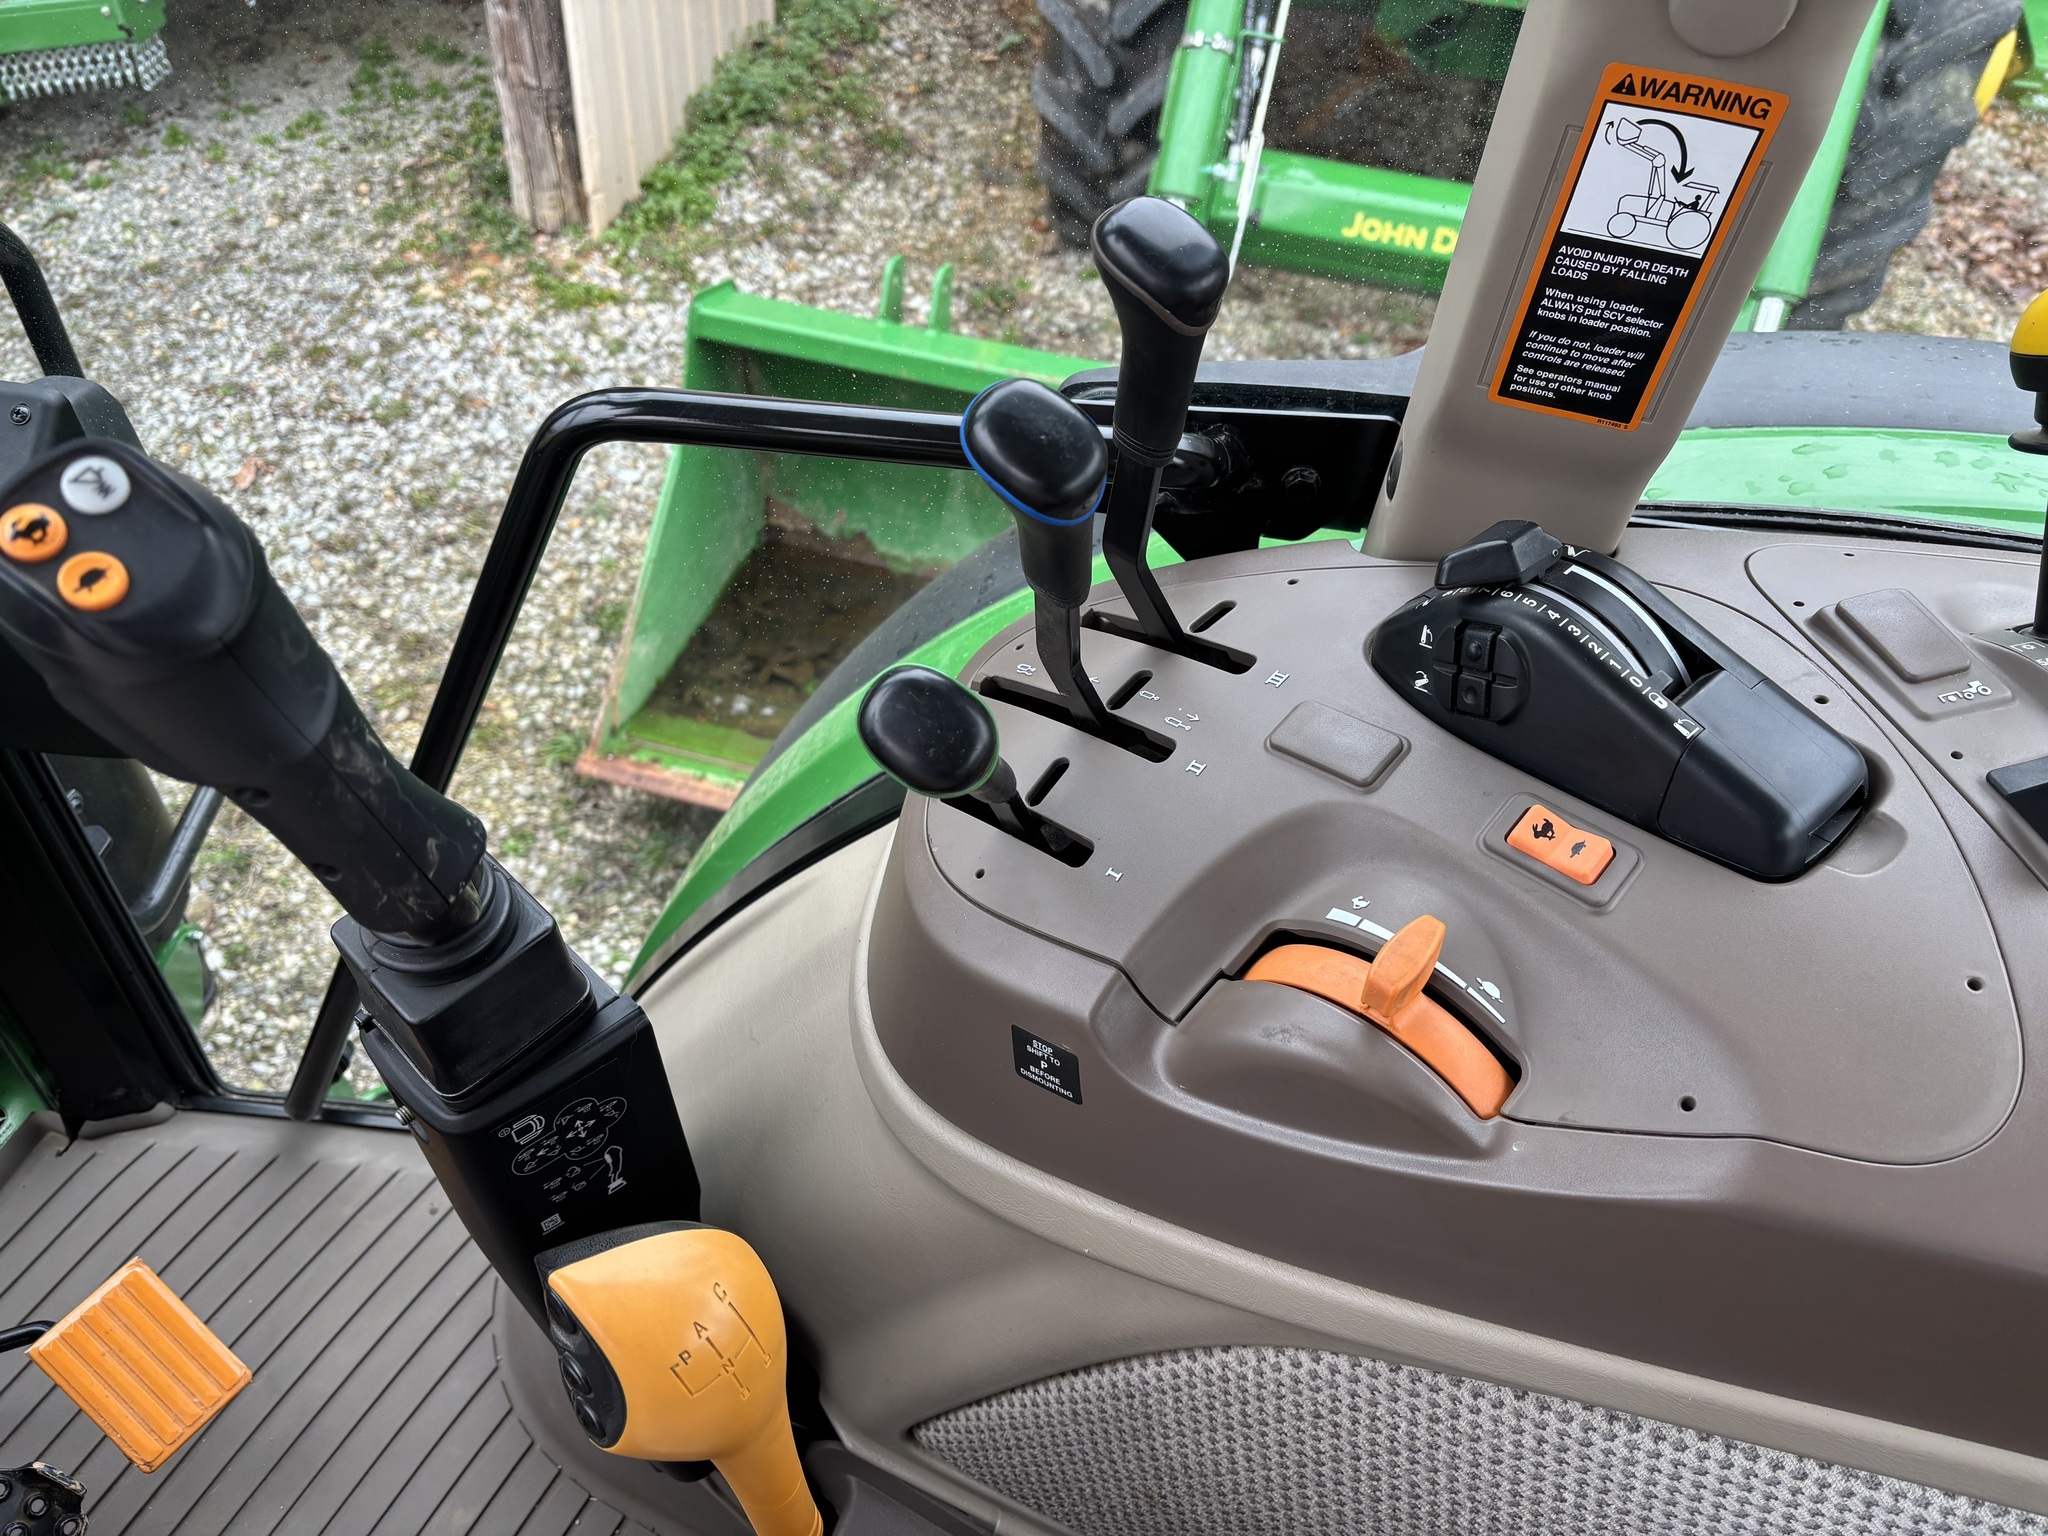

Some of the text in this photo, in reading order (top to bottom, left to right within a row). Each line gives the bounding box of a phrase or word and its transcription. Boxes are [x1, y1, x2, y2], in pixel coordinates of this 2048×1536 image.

[1640, 76, 1772, 120] WARNING
[1341, 211, 1428, 250] JOHN
[1555, 256, 1668, 285] CAUSED BY FALLING
[1559, 245, 1689, 278] AVOID INJURY OR DEATH
[1551, 266, 1588, 281] LOADS
[1545, 287, 1644, 314] When using loader
[1537, 308, 1651, 338] knobs in loader position.
[1540, 298, 1664, 329] ALWAYS put SCV selector
[1525, 341, 1636, 369] continue to move after
[1529, 330, 1645, 361] If you do not, loader will
[1522, 350, 1626, 378] controls are released.
[1513, 374, 1527, 382] for
[1529, 378, 1546, 387] use
[1560, 384, 1586, 396] other
[1588, 390, 1612, 401] knob
[1517, 364, 1621, 393] See operators manual
[1510, 384, 1556, 399] positions.
[1500, 590, 1514, 598] 6
[1522, 597, 1537, 607] 5
[1548, 609, 1561, 620] 4
[1567, 625, 1581, 636] 3
[1588, 641, 1602, 654] 2
[1609, 659, 1622, 669] 1
[1265, 670, 1290, 688] III
[1629, 676, 1643, 688] 0
[1185, 760, 1207, 776] II
[1105, 867, 1123, 882] I
[1026, 1045, 1060, 1066] SHIFT TO
[1032, 1040, 1053, 1054] STOP
[1041, 1060, 1048, 1069] P
[1020, 1068, 1073, 1098] DISMOUNTING
[1030, 1065, 1060, 1085] BEFORE
[712, 1282, 727, 1303] C
[693, 1321, 709, 1340] A
[678, 1349, 692, 1366] P
[722, 1358, 735, 1374] N
